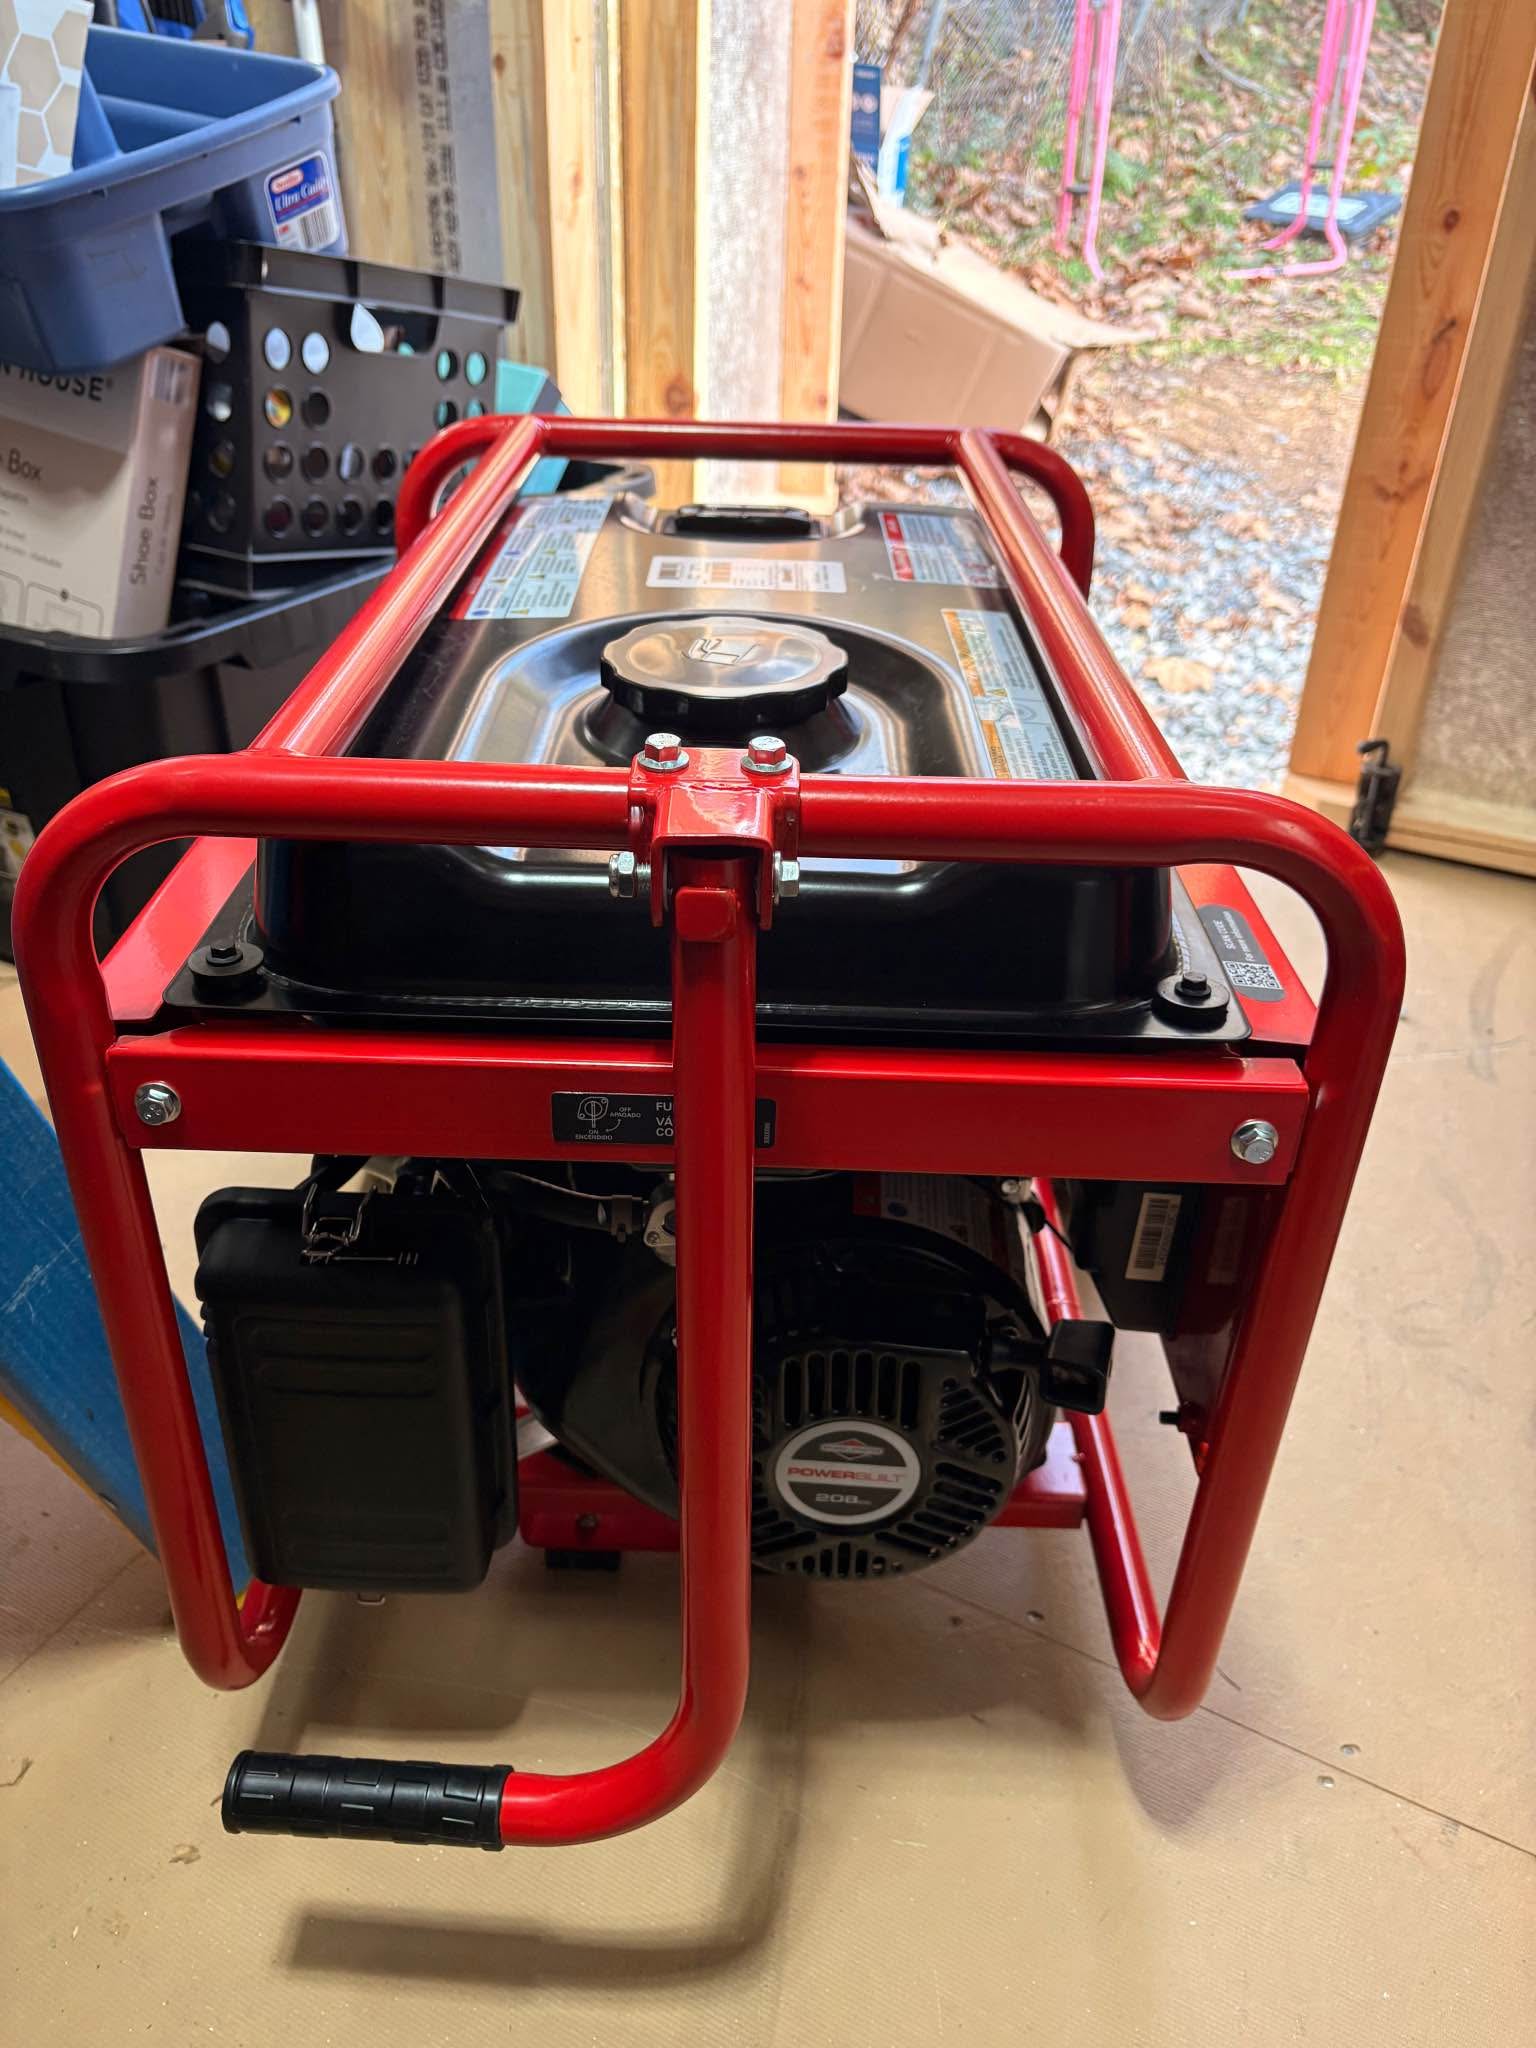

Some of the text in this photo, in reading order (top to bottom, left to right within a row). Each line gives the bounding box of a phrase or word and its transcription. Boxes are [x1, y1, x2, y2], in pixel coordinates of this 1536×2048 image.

[7, 447, 44, 481] Box
[130, 476, 158, 585] Shoe Box
[656, 1101, 673, 1112] FU
[656, 1116, 673, 1127] VÁ
[656, 1127, 674, 1137] CO
[786, 1467, 905, 1483] POWERBUILT
